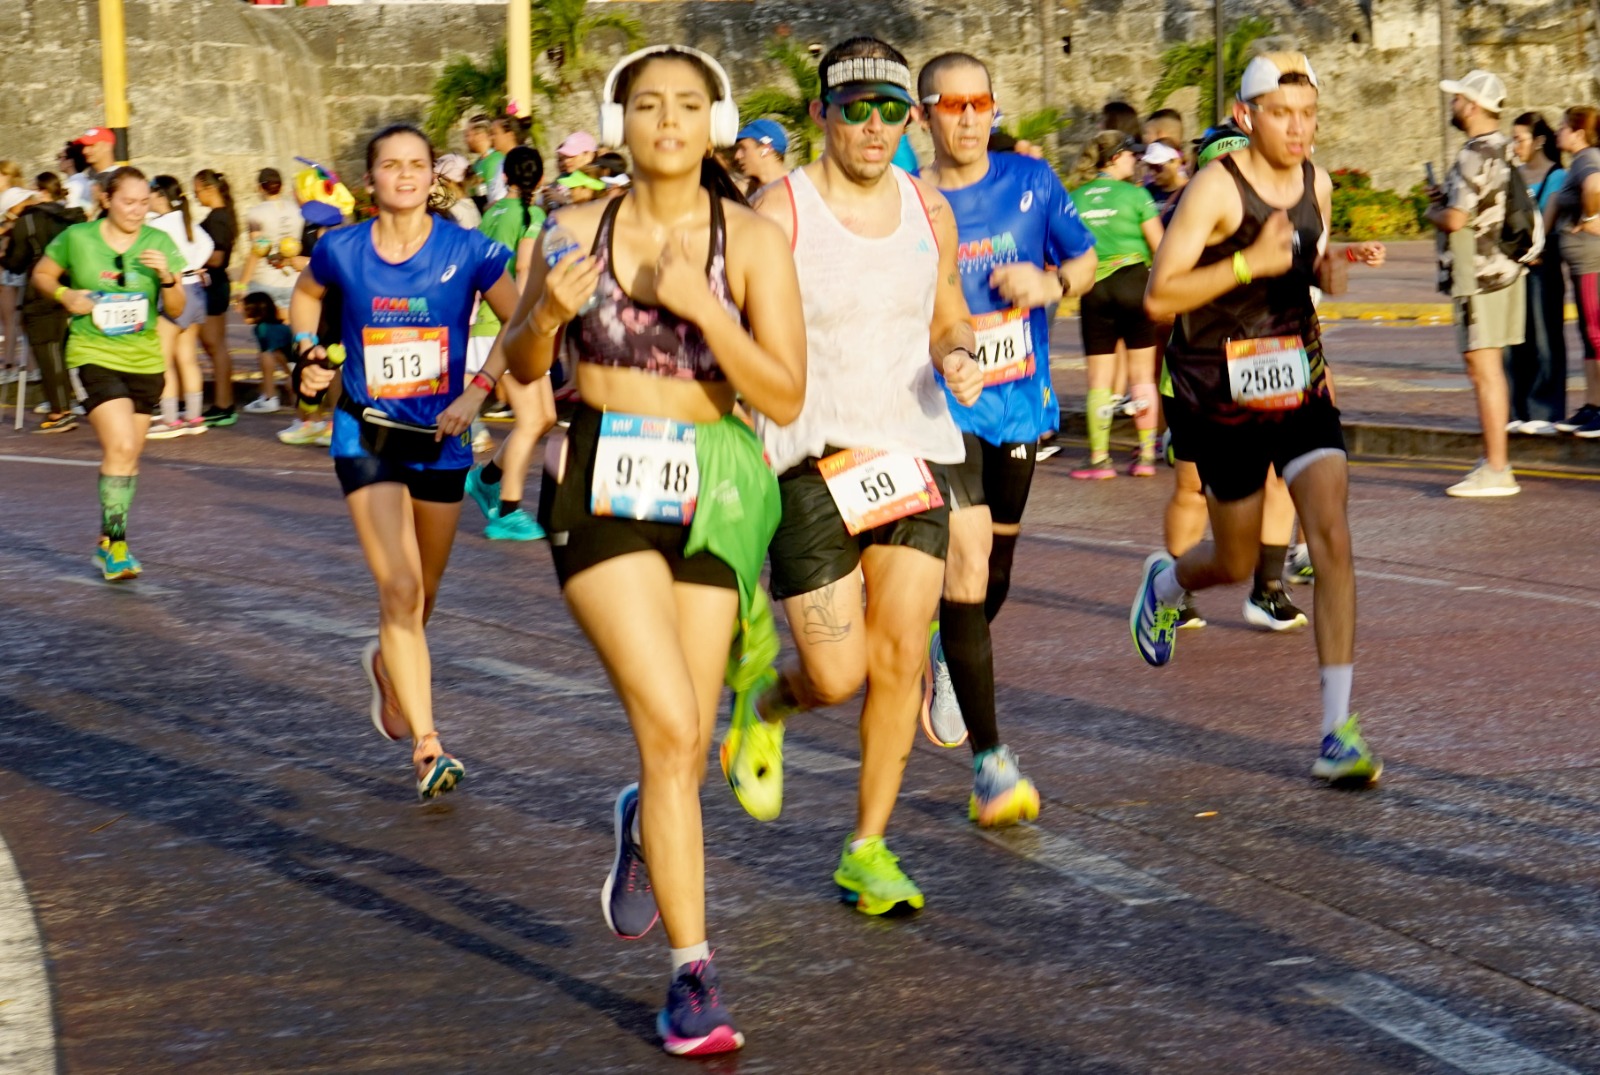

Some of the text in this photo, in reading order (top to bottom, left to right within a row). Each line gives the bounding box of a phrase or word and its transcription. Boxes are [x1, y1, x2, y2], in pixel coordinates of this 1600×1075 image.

[382, 354, 421, 379] 513
[1240, 364, 1295, 393] 2583
[859, 472, 896, 503] 59
